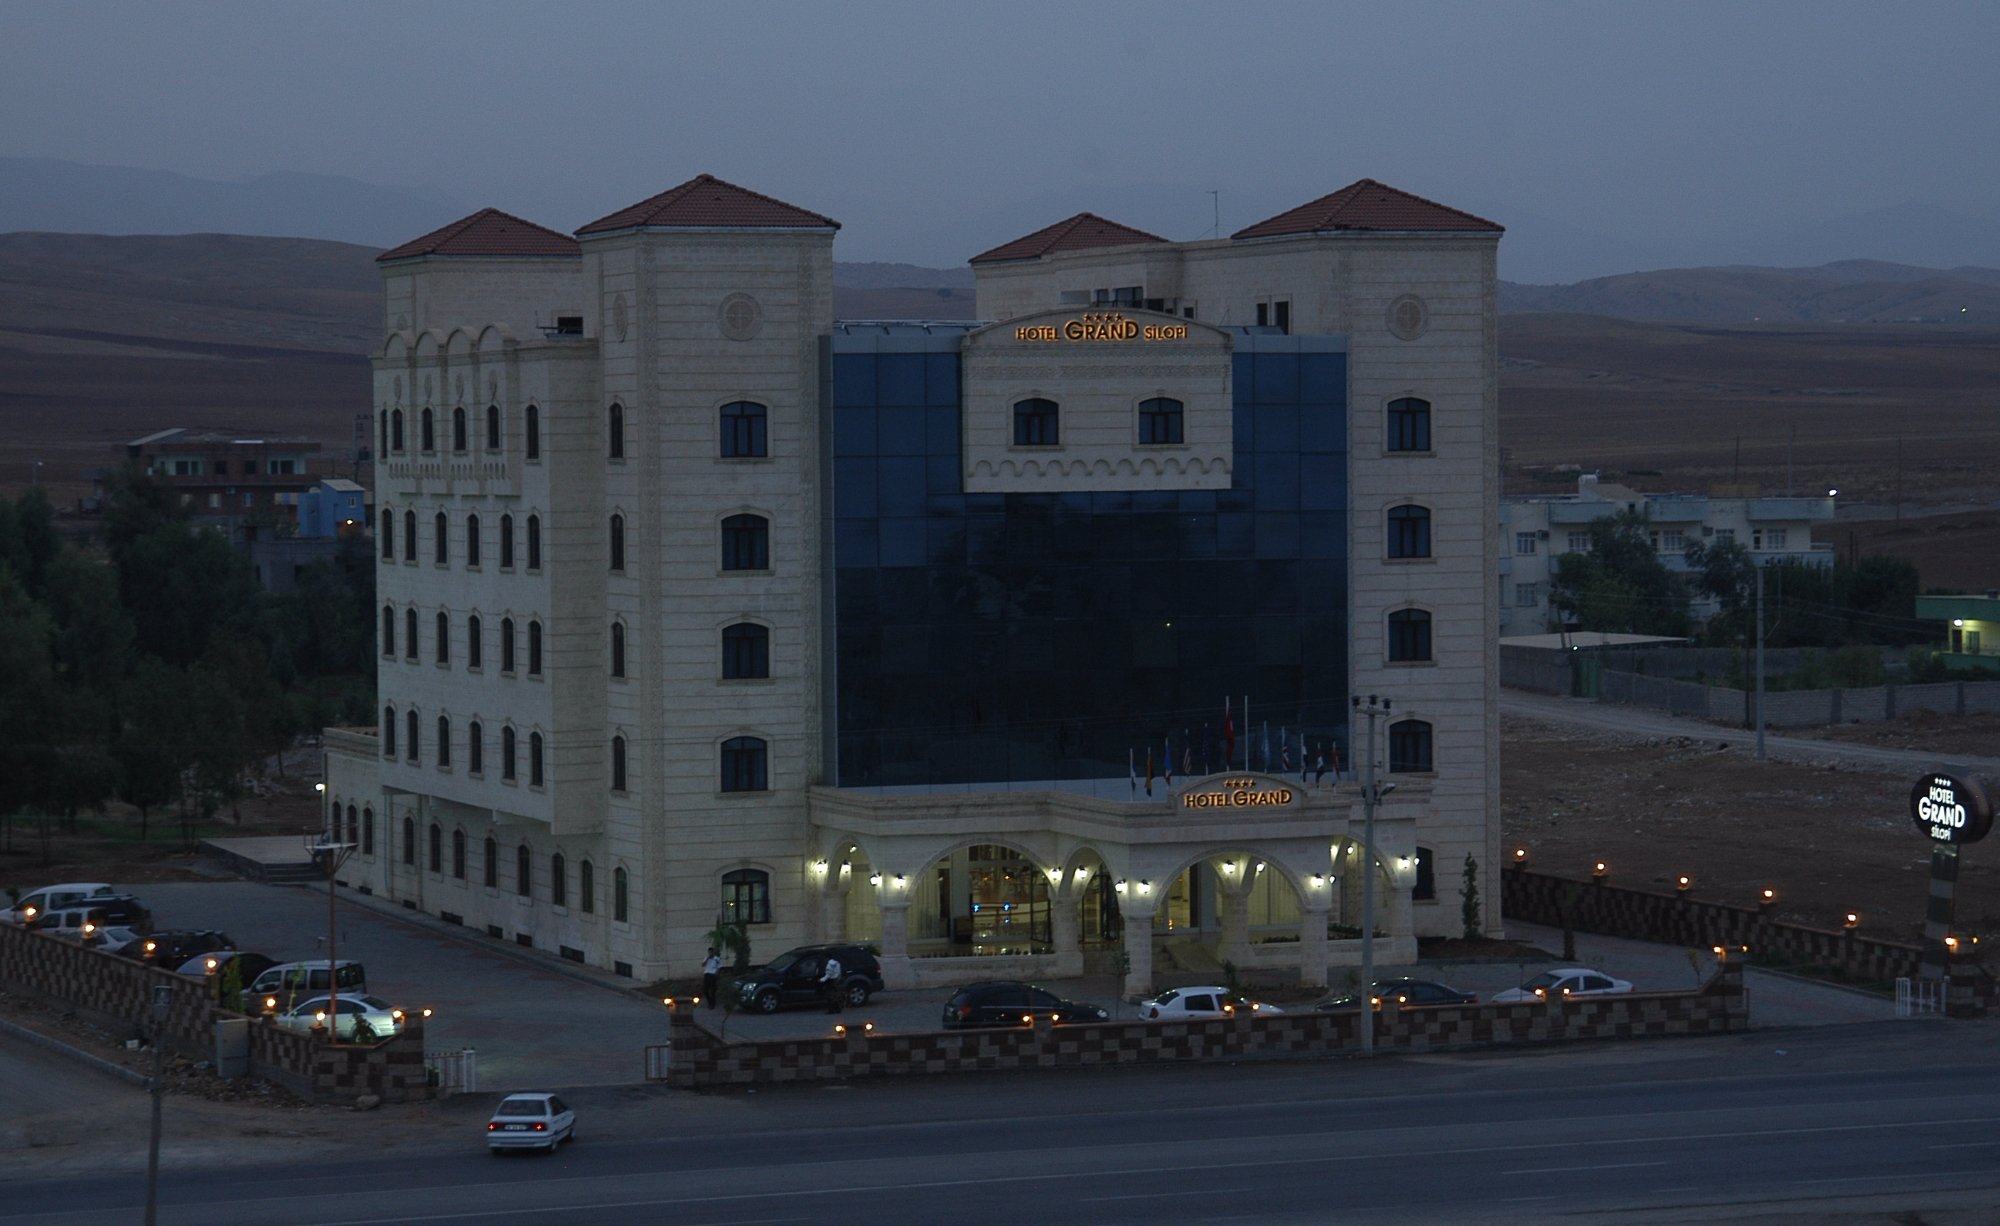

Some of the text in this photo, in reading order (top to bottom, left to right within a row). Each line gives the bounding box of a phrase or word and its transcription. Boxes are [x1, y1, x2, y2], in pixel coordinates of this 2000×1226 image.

[1016, 325, 1060, 340] HOTEL
[1064, 320, 1139, 341] GRAND
[1184, 788, 1292, 808] HOTEL GRAND
[1929, 786, 1955, 805] HOTEL
[1918, 796, 1966, 828] GRAND
